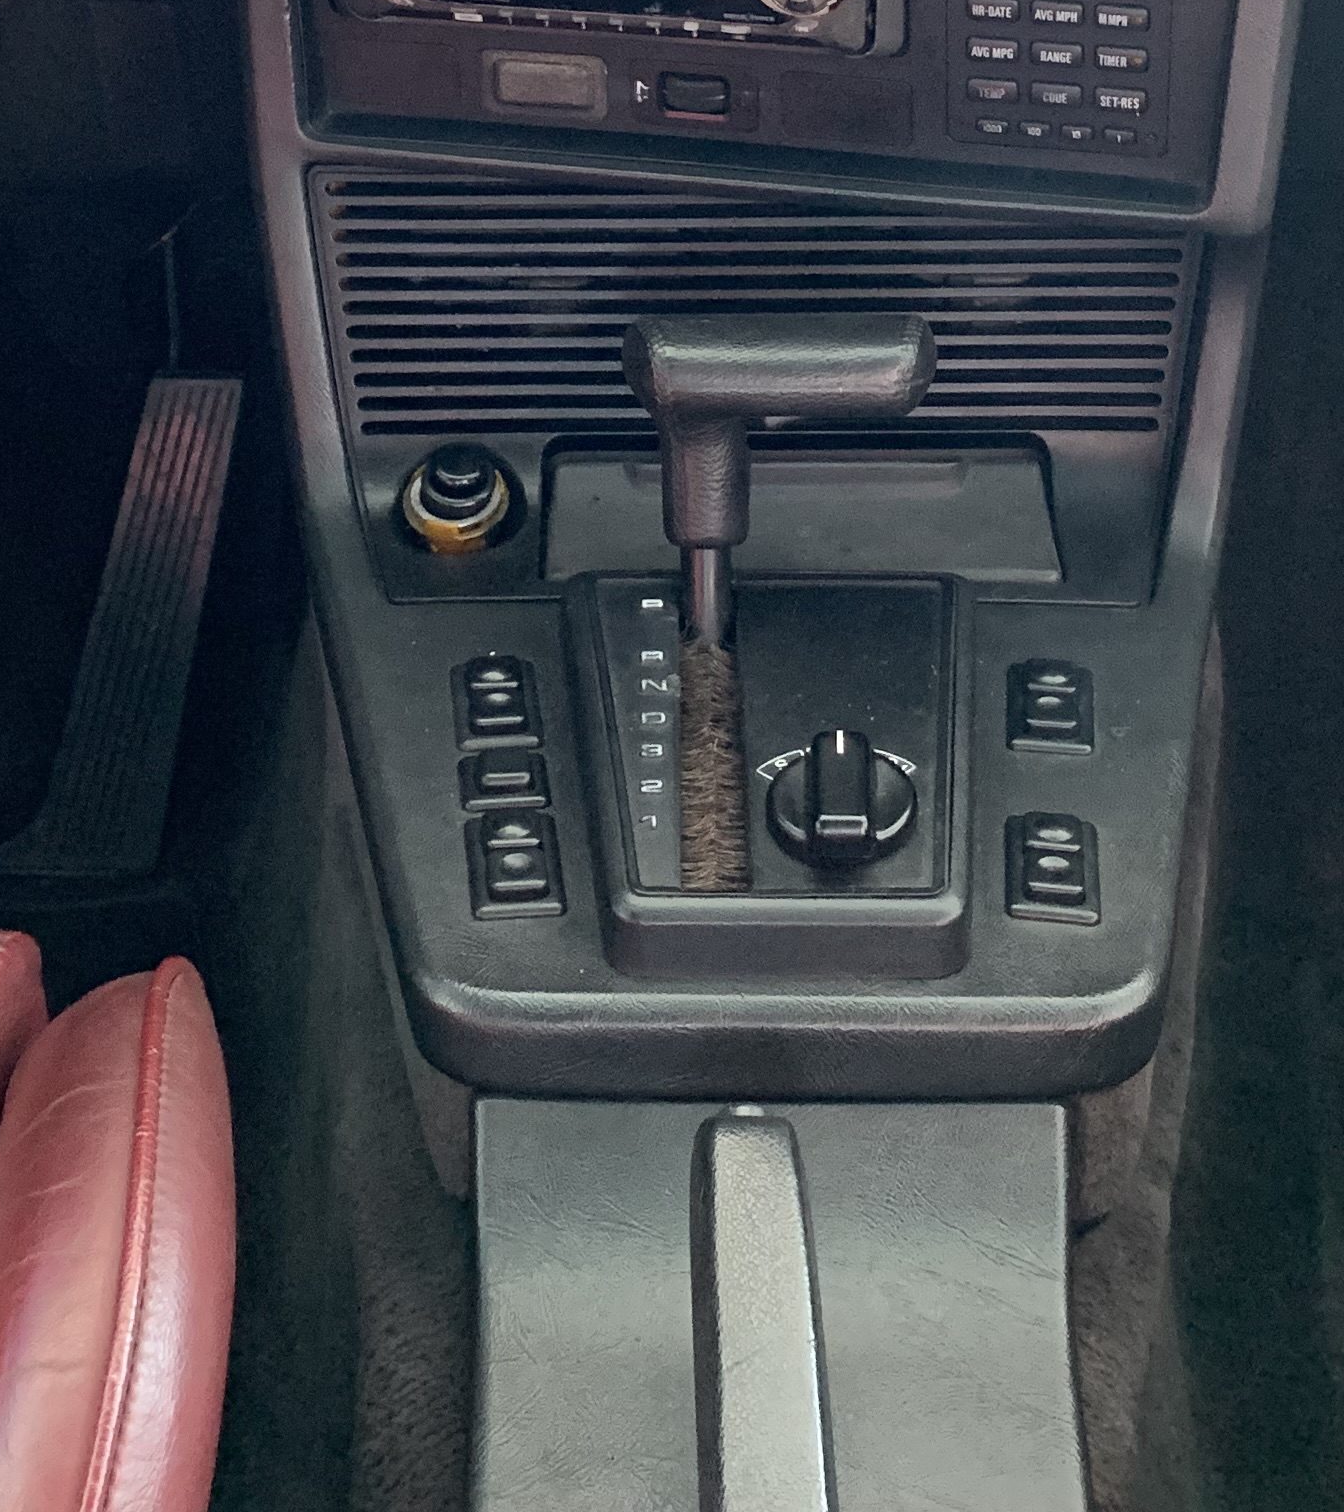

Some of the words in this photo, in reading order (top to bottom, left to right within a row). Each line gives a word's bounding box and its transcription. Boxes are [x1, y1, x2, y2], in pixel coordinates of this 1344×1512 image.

[972, 4, 1012, 19] HR-DATE
[1034, 8, 1053, 21] AVG
[1055, 10, 1078, 24] MPH
[971, 46, 990, 59] AVG
[992, 47, 1014, 60] MPG
[1040, 50, 1072, 65] RANGE
[1099, 53, 1127, 68] TIMER
[1100, 96, 1140, 110] SET-RES
[640, 711, 666, 725] D
[640, 743, 664, 758] 3
[640, 779, 664, 794] 2
